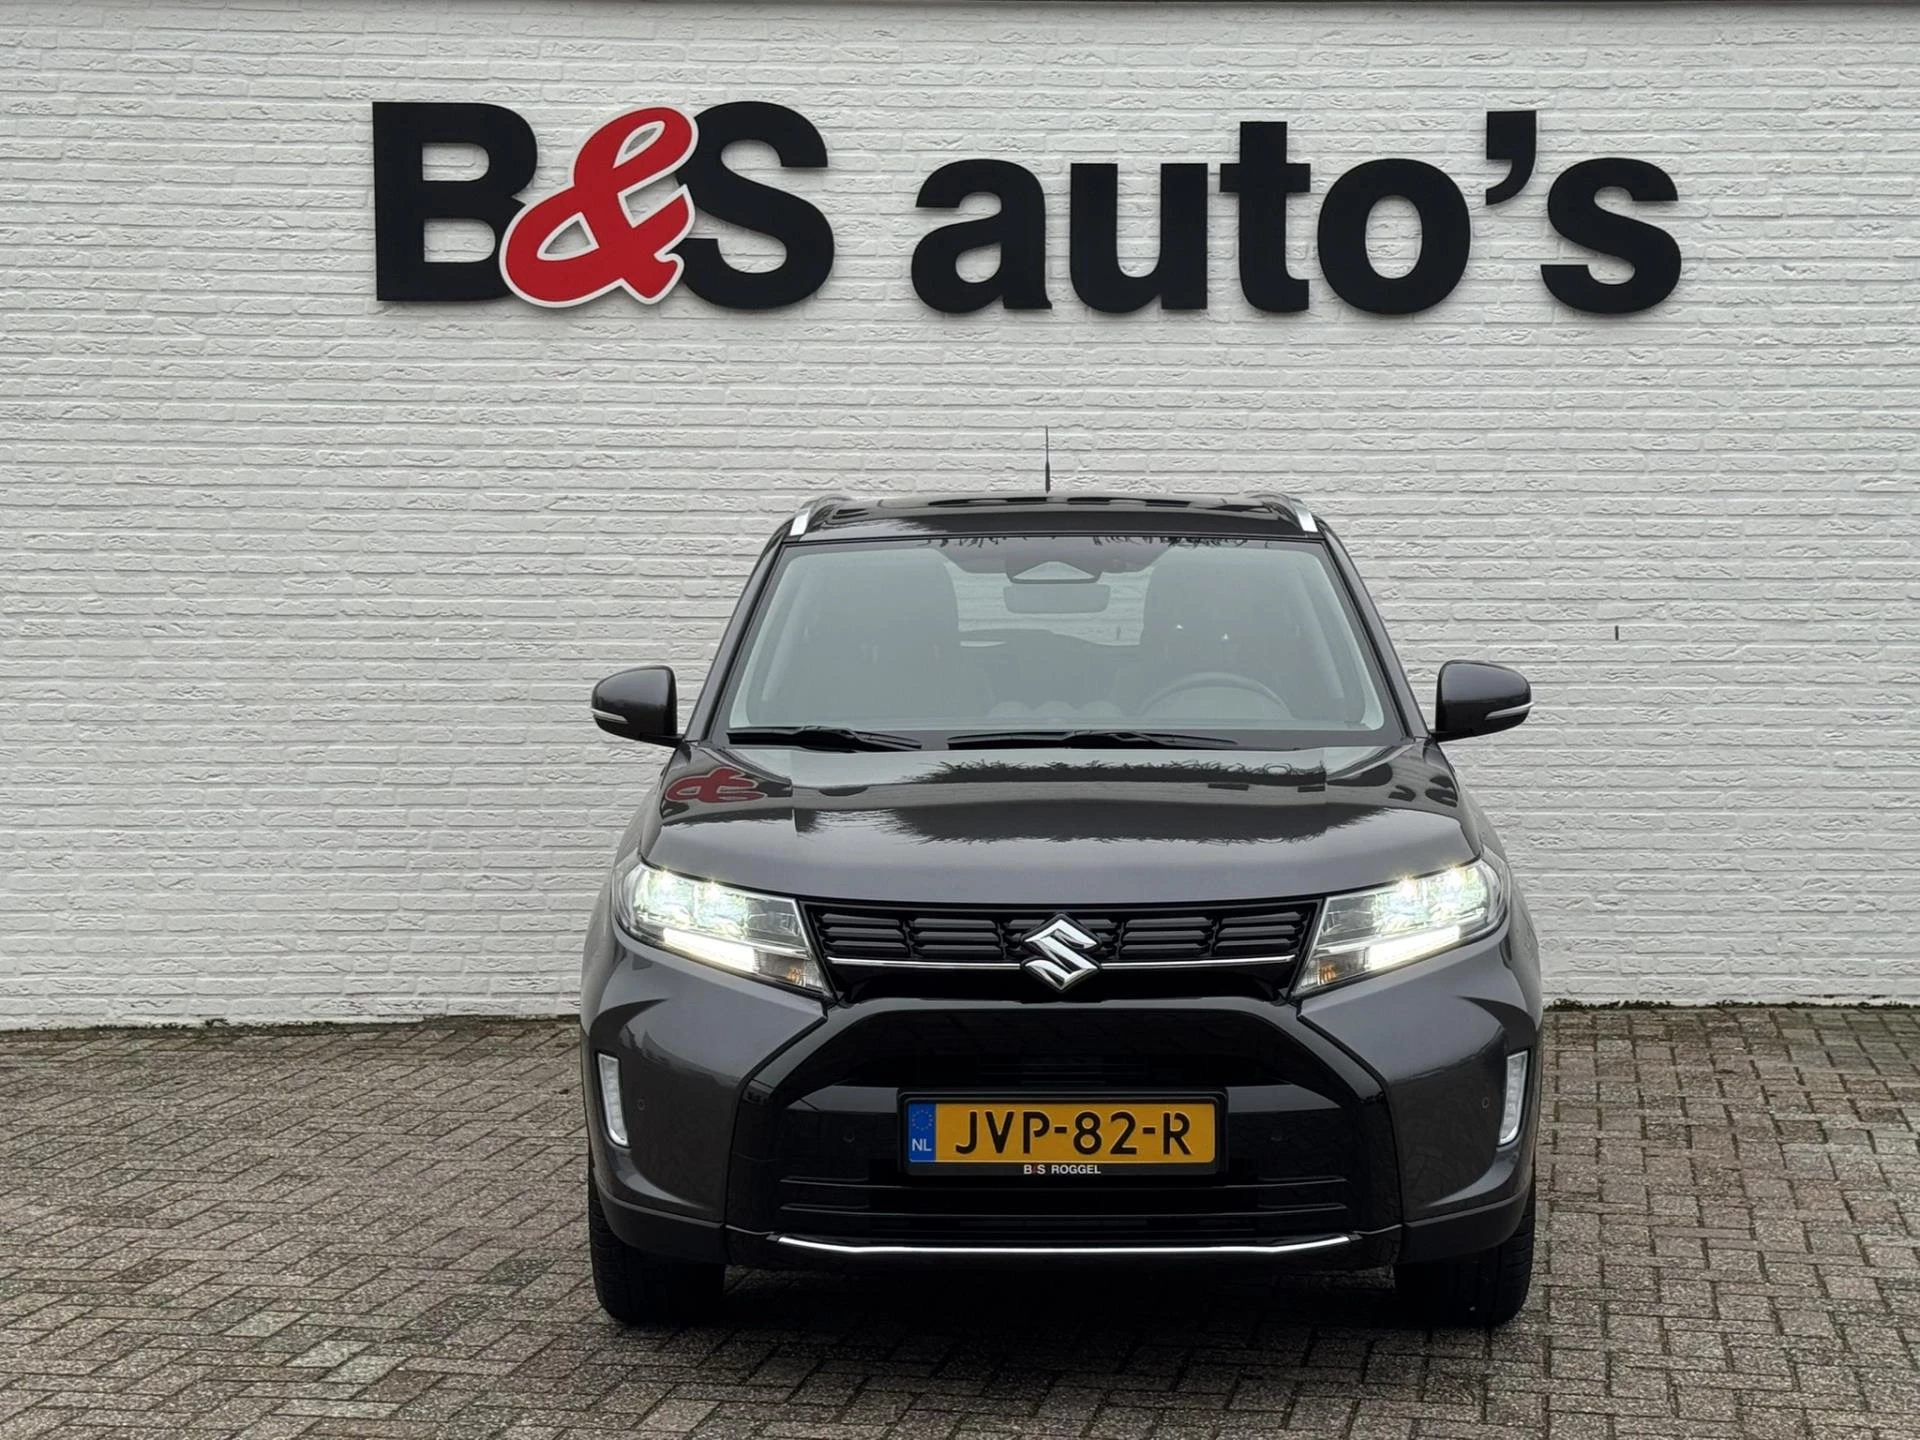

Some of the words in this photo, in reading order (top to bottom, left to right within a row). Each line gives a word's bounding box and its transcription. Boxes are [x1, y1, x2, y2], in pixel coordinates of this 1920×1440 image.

[372, 101, 835, 309] B&S
[911, 110, 1682, 315] auto's
[911, 1138, 932, 1152] NL
[955, 1111, 1191, 1155] JVP-82-R
[1051, 1164, 1102, 1175] ROGGEL
